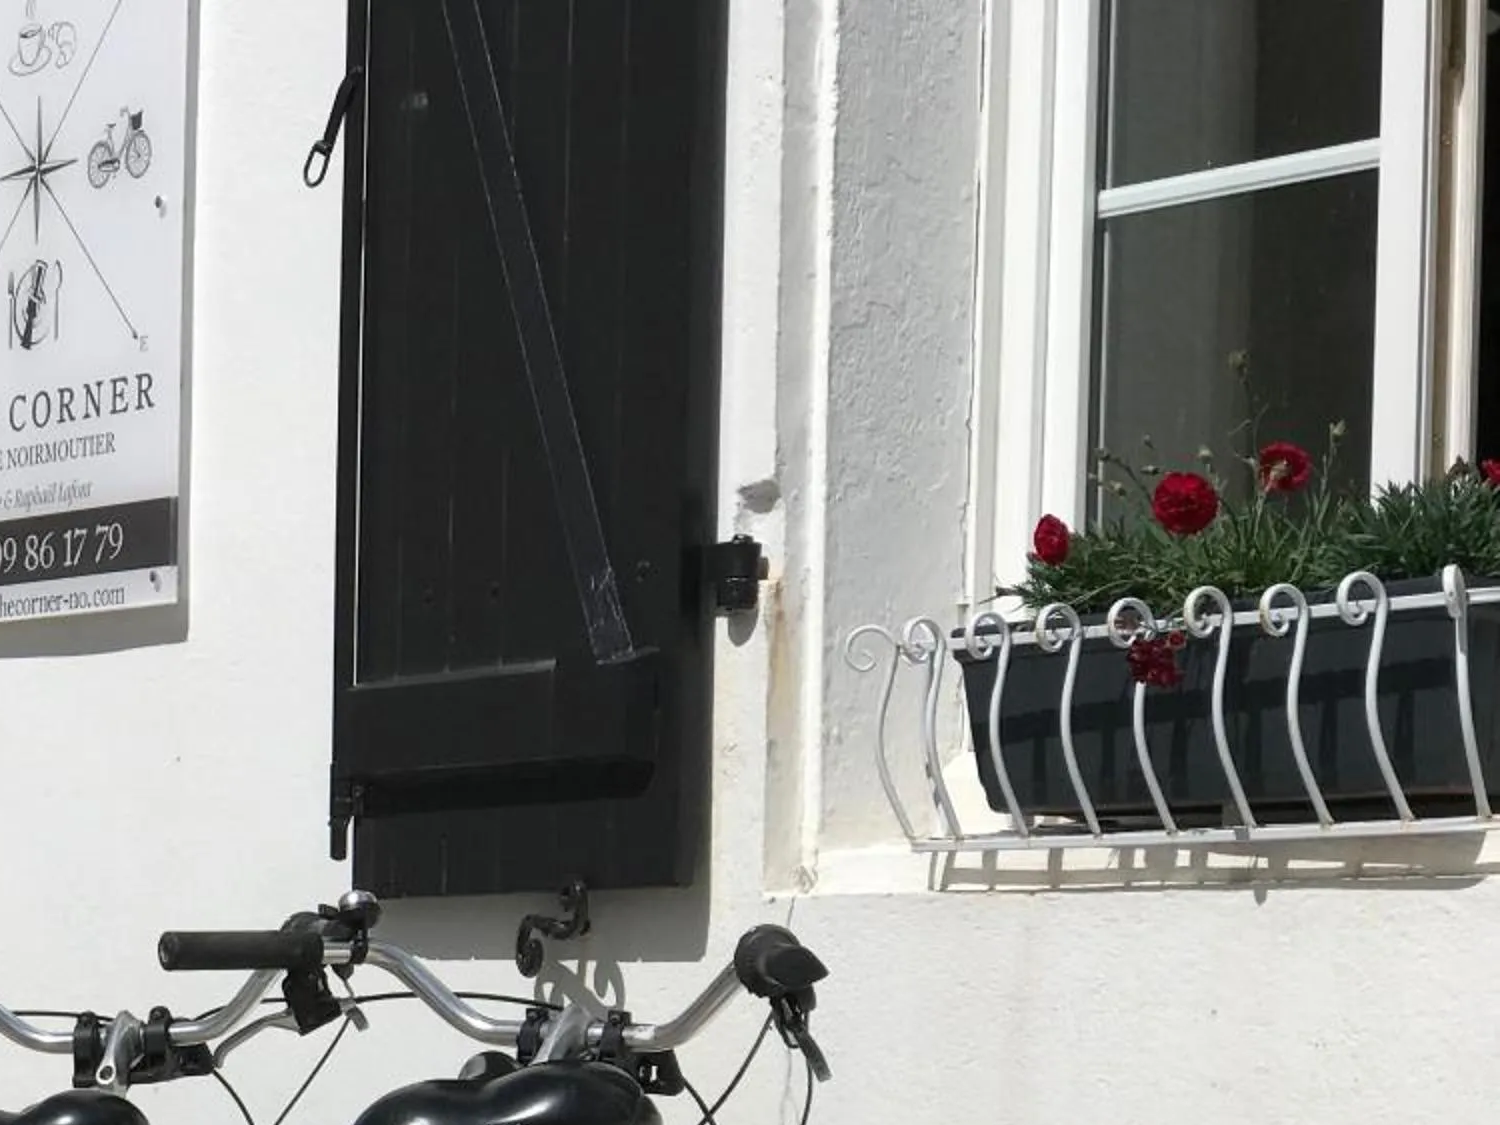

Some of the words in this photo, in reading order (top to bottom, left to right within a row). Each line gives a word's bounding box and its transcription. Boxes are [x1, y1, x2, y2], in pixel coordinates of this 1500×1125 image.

[8, 372, 156, 432] CORNER
[6, 431, 117, 471] NOIRMOUTIER
[24, 531, 55, 572] 86
[63, 528, 88, 568] 17
[95, 522, 124, 564] 79
